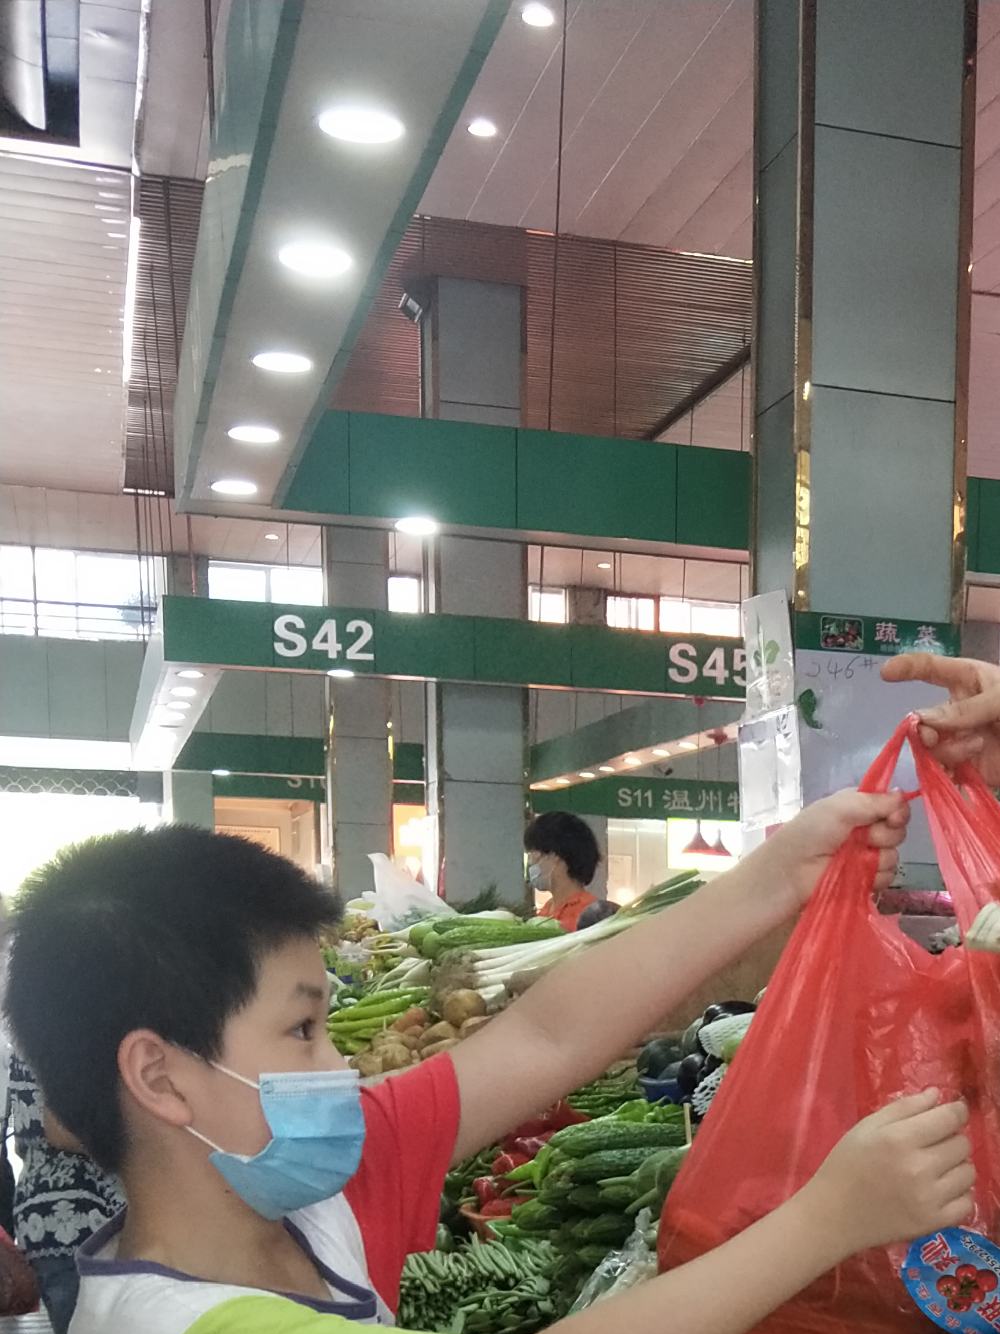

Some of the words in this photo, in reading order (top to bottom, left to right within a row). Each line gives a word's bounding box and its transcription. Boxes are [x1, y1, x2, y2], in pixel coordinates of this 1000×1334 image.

[273, 614, 375, 660] S42
[668, 643, 747, 687] S45
[617, 788, 653, 808] S11
